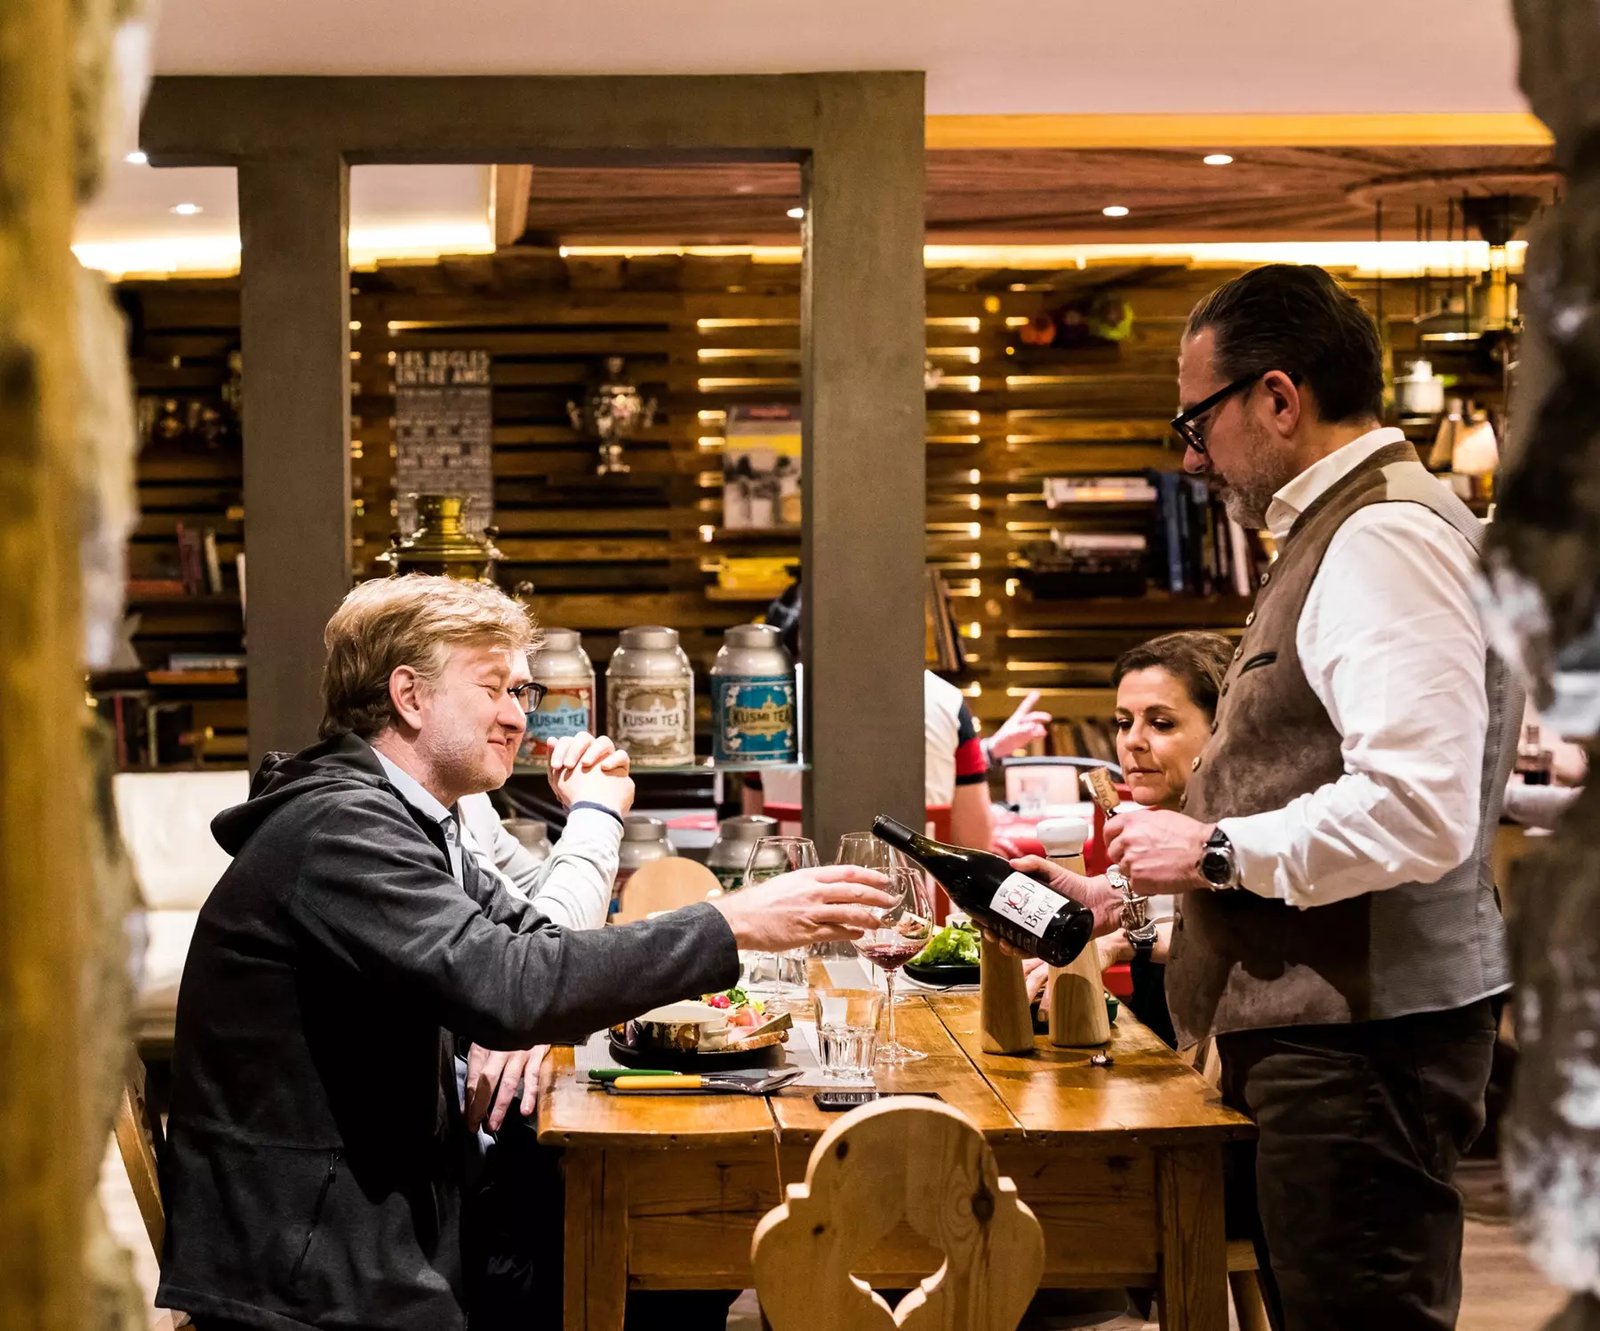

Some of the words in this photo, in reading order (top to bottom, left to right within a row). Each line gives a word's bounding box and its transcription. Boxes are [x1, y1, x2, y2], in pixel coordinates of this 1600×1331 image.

[527, 713, 564, 727] KUSMI
[568, 713, 585, 726] TEA
[622, 712, 657, 727] KUSMI
[662, 712, 679, 727] TEA
[733, 708, 770, 723] KUSMI
[773, 708, 790, 723] TEA
